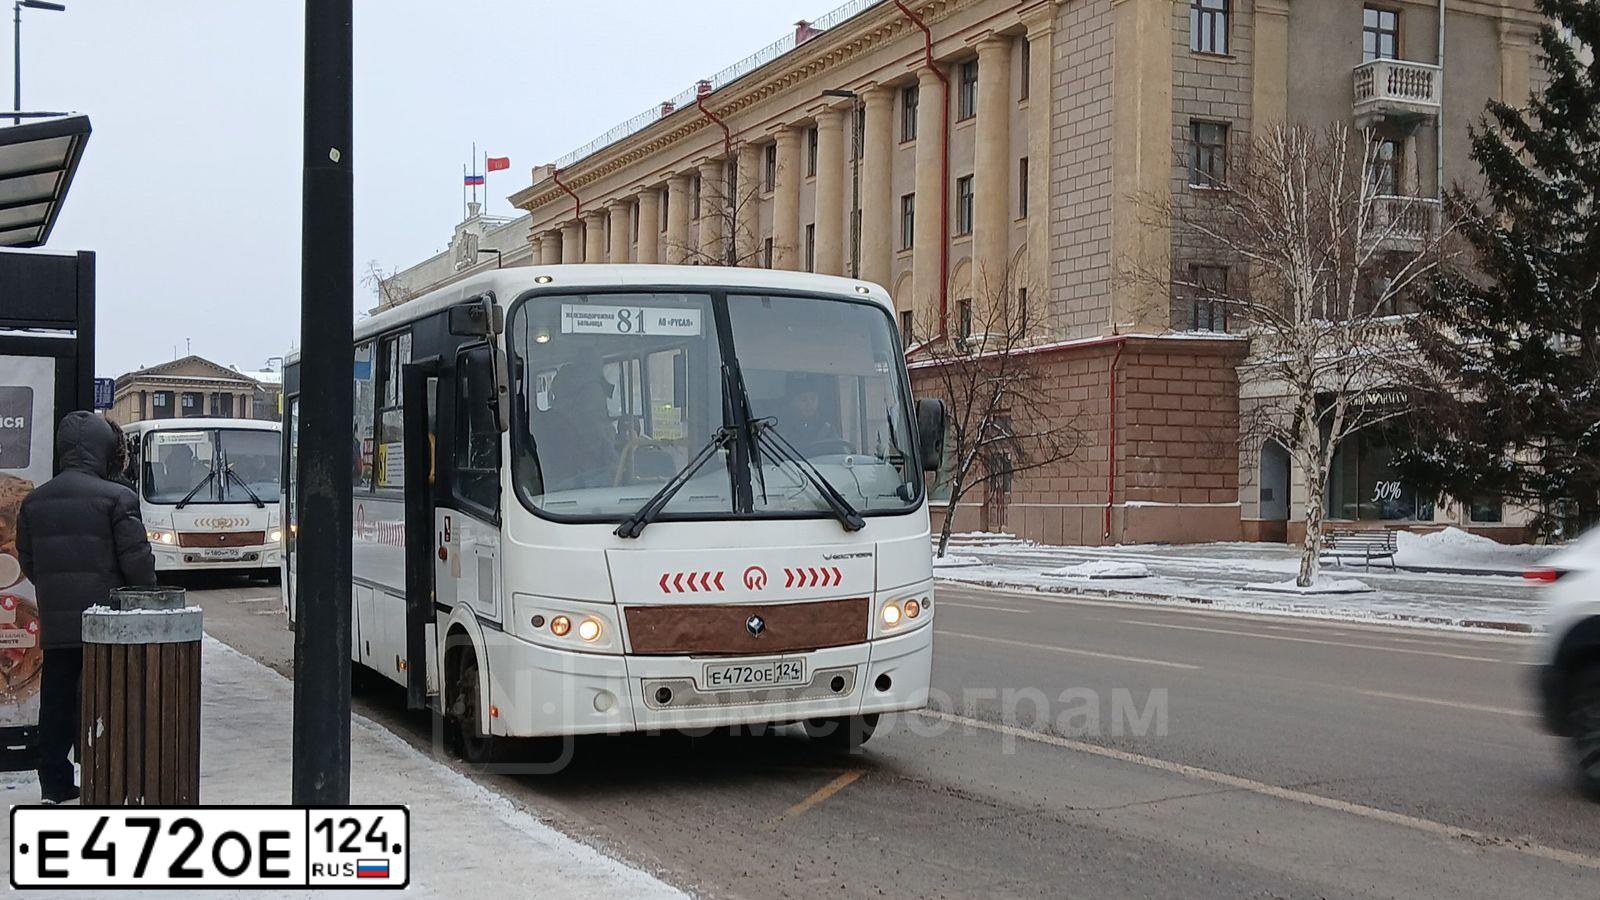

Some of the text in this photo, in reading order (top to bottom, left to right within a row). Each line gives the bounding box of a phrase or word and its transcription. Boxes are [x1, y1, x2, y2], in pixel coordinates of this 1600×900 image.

[617, 308, 645, 333] 81
[658, 317, 666, 326] АО
[1370, 480, 1402, 502] 50%
[713, 667, 773, 684] Е472ОЕ
[776, 663, 800, 676] 124
